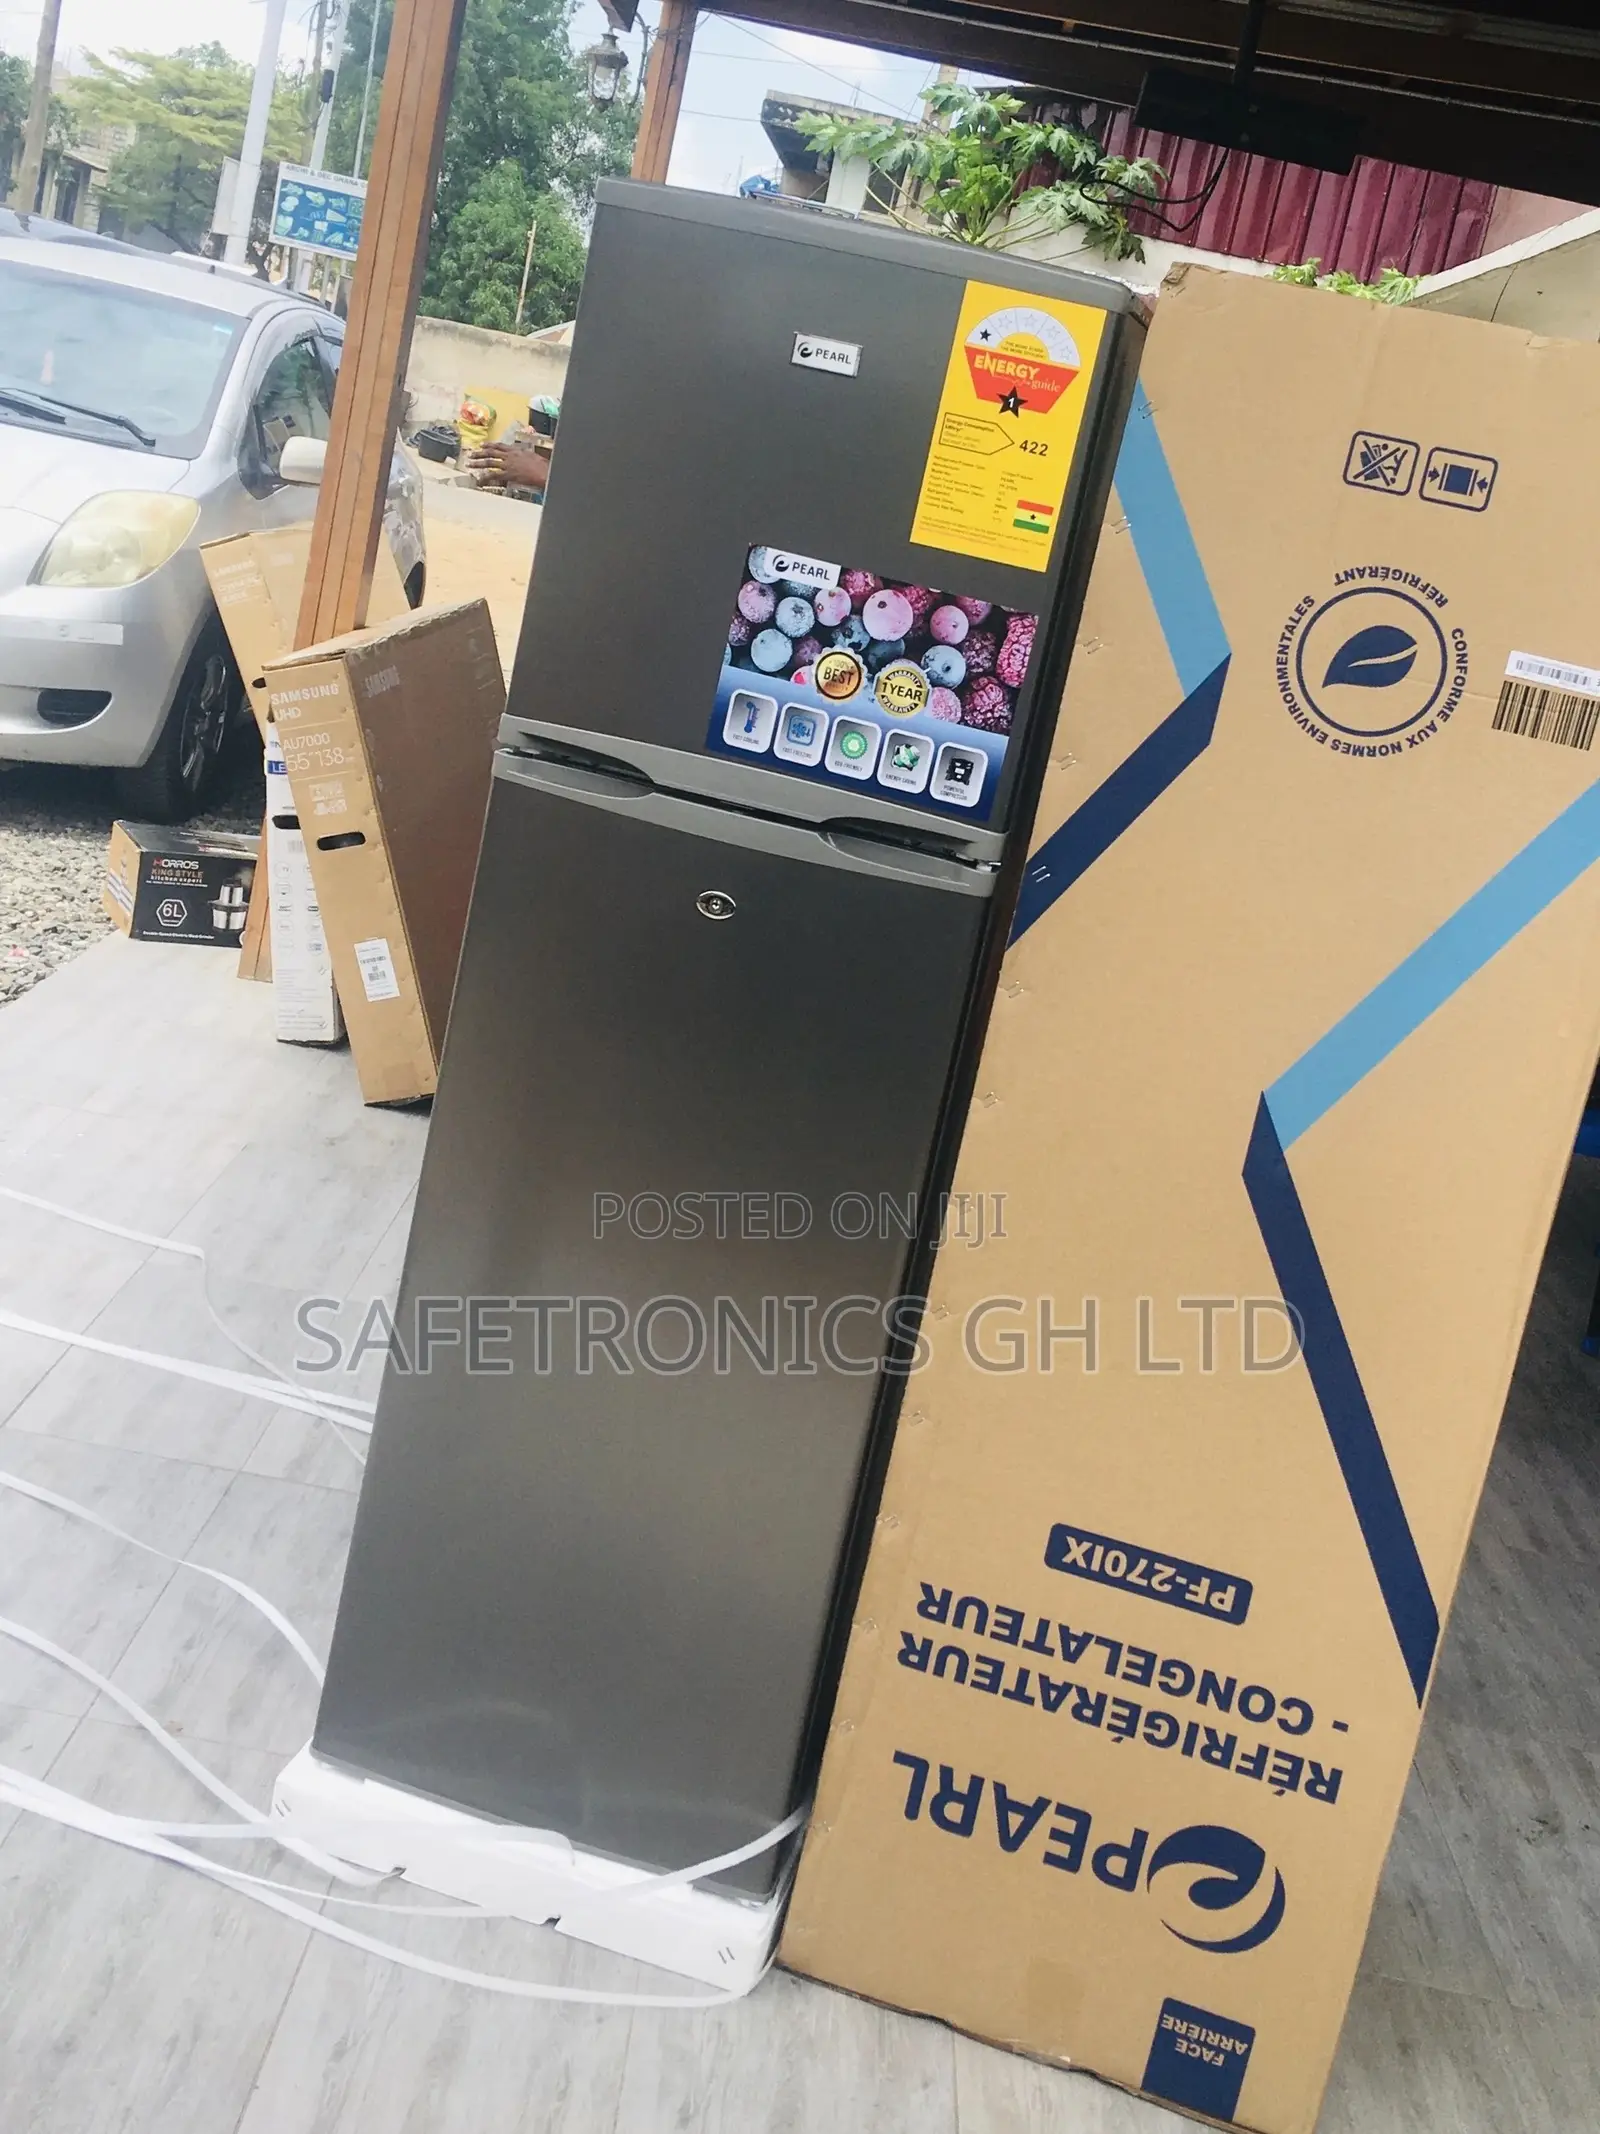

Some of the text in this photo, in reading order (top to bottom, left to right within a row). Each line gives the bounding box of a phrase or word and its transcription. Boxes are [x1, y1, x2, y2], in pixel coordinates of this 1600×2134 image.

[815, 348, 852, 364] PEARL
[974, 352, 1061, 392] ENERGY guide
[1008, 398, 1015, 408] 1
[1019, 440, 1049, 456] 422
[792, 562, 831, 581] PEARL
[1334, 566, 1448, 608] RÉFRIGÉRANT
[824, 668, 854, 686] BEST
[1276, 595, 1468, 758] CONFORME AUX NORMES ENVIRONMENTALES
[271, 683, 340, 705] SAMSUNG
[882, 682, 922, 702] 1 YEAR
[275, 707, 301, 720] UHD
[283, 732, 330, 750] AU7000
[152, 868, 204, 878] KING STYLE
[162, 903, 182, 918] 6L
[1062, 1535, 1238, 1614] PF-270IX
[916, 1581, 1314, 1736] CONGELATEUR
[896, 1630, 1344, 1805] RÉFRIGÉRATEUR
[892, 1749, 1150, 1893] PEARL
[1174, 2038, 1225, 2067] FACE
